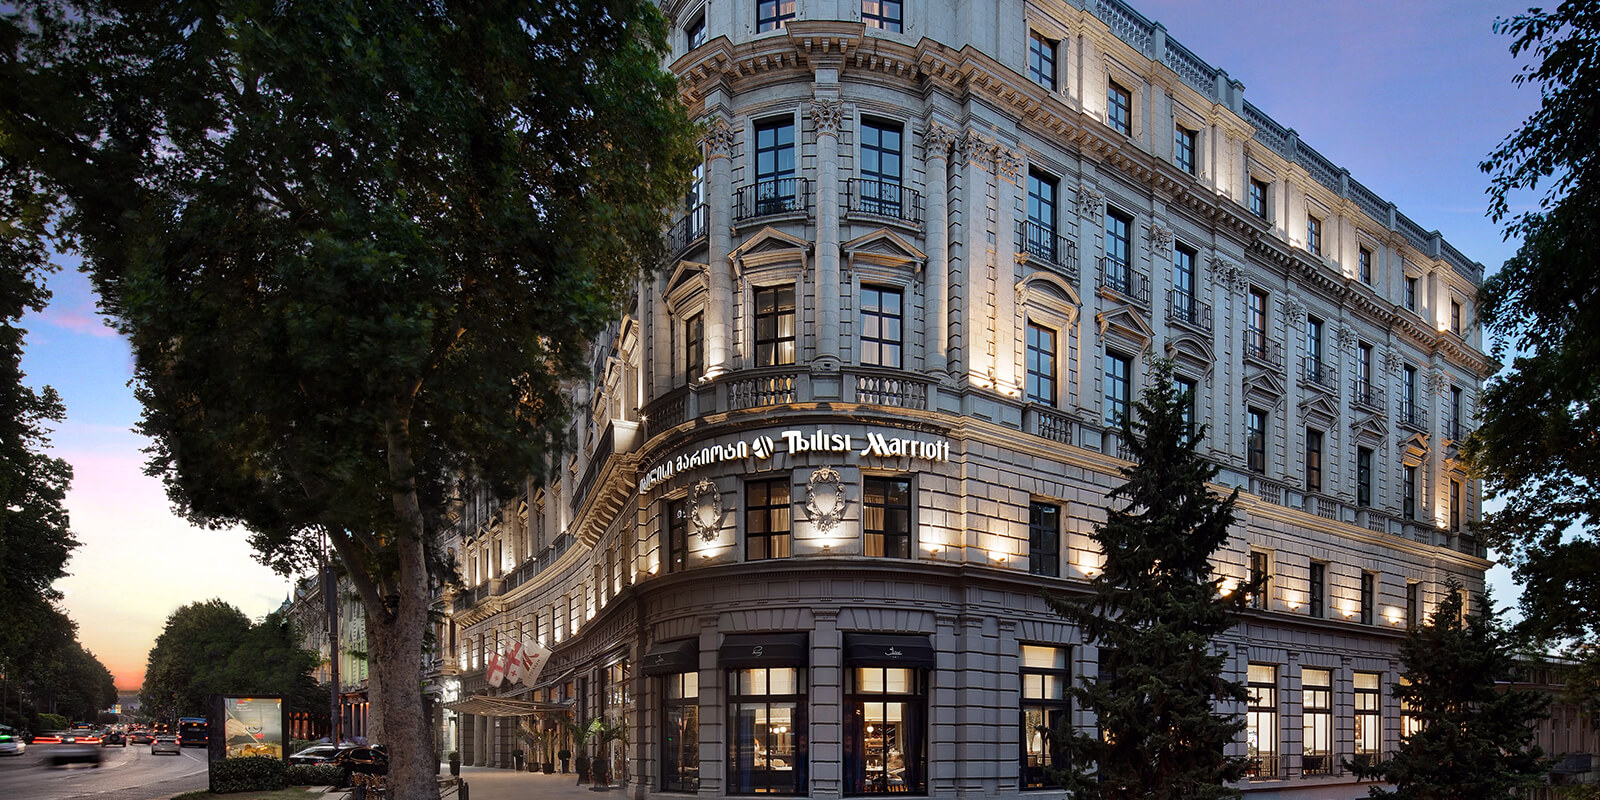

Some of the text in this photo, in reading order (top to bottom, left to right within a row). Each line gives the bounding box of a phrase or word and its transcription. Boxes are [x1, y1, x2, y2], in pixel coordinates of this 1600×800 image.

[676, 440, 748, 472] მარიოტი
[781, 429, 950, 462] Tbilisi Marriott
